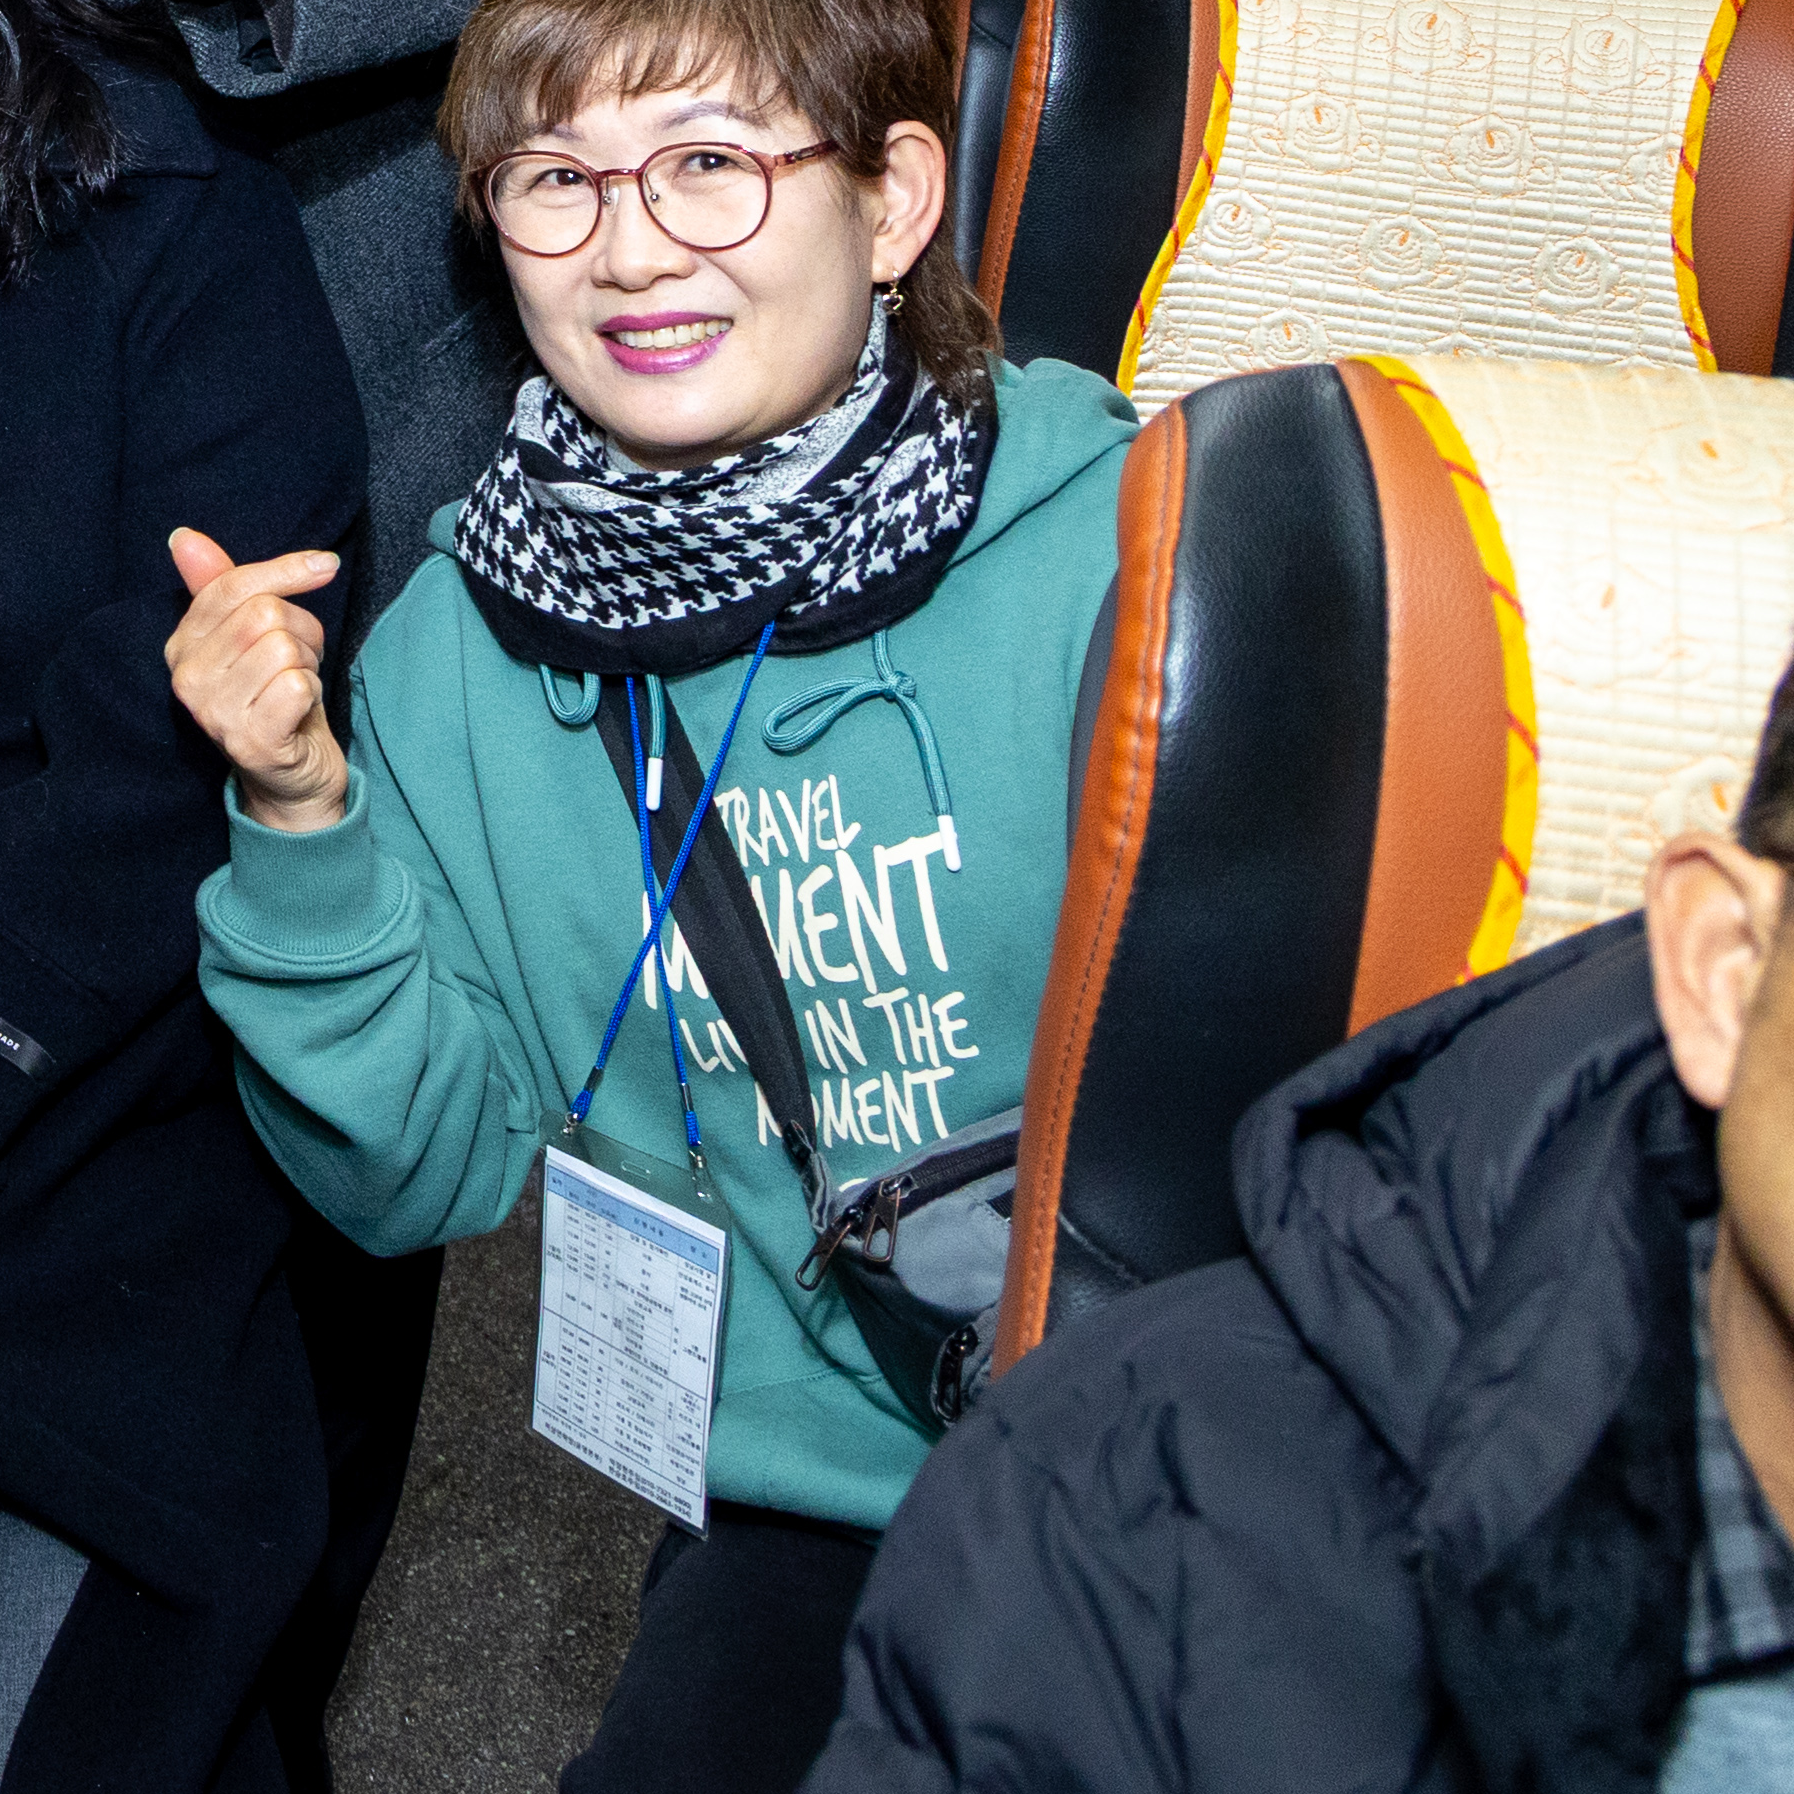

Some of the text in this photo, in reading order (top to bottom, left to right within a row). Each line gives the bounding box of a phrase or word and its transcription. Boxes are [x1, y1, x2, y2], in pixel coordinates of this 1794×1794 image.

[714, 774, 861, 867] TRAVEL
[641, 831, 957, 1009] MMENT
[804, 998, 868, 1074] IN
[862, 987, 980, 1067] THE
[754, 1066, 955, 1153] MMENT
